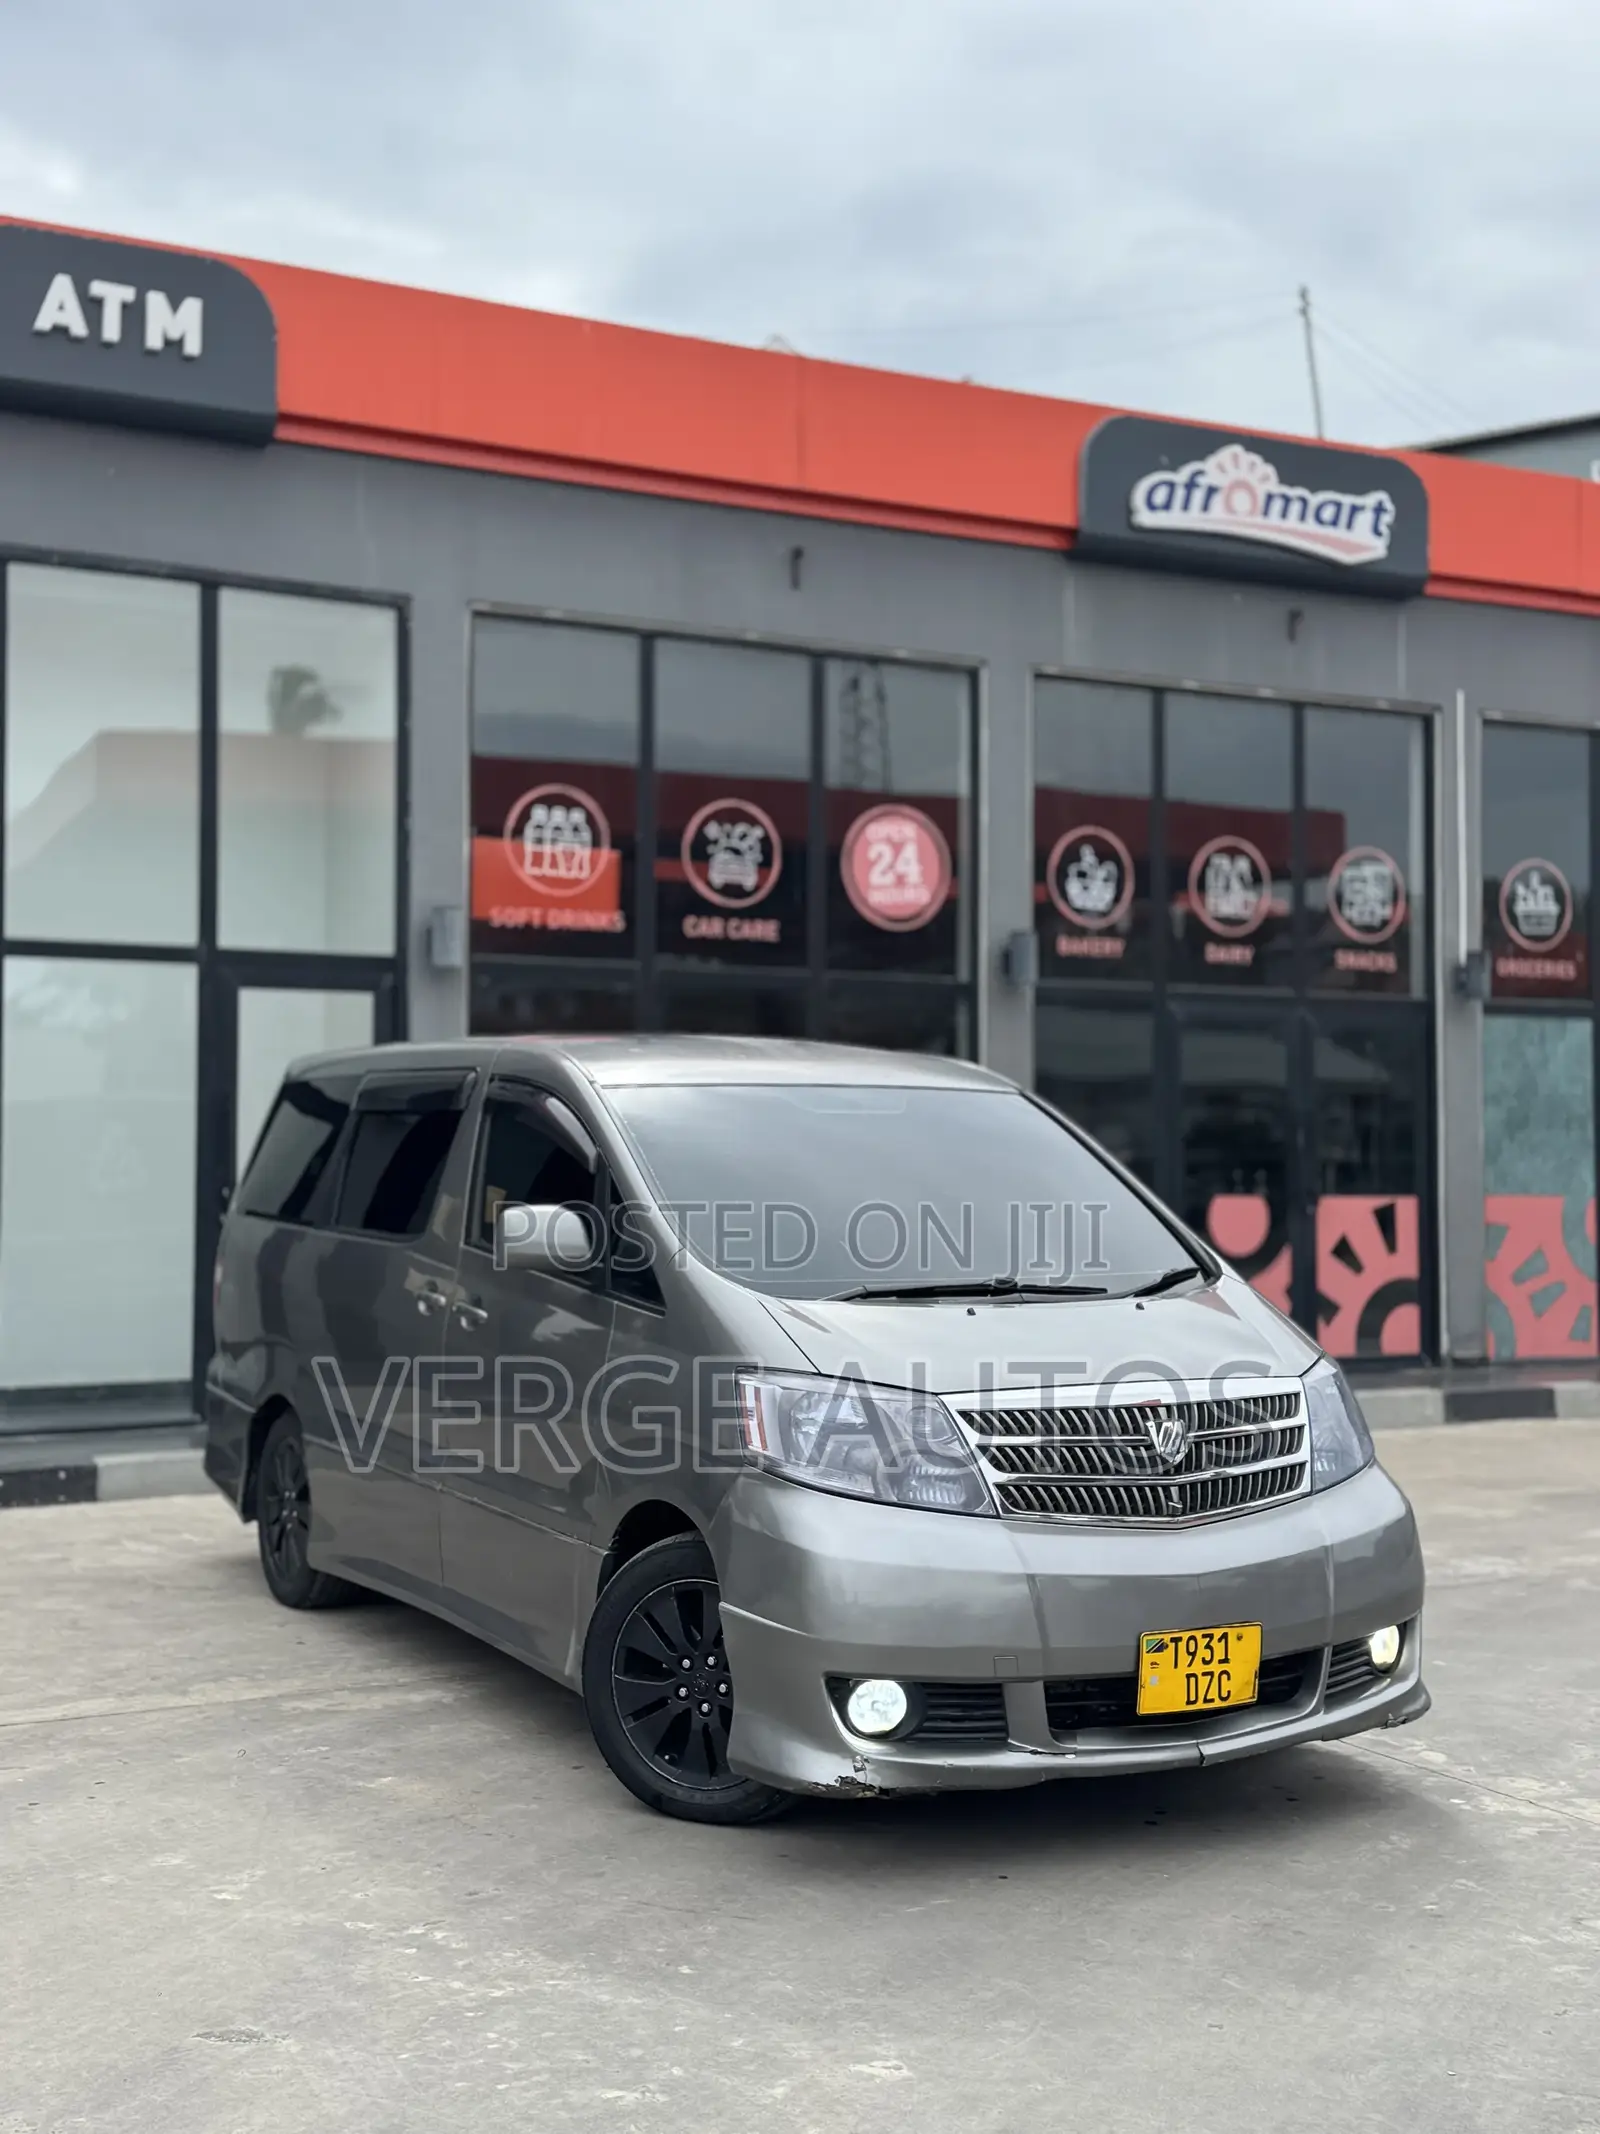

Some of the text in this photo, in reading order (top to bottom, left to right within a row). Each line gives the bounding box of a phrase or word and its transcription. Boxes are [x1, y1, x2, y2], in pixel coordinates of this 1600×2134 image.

[32, 273, 203, 358] ATM
[1144, 468, 1391, 538] afromart
[867, 842, 924, 886] 24
[488, 905, 627, 934] SOFT DRINKS
[682, 914, 782, 943] CAR CARE
[1169, 1632, 1231, 1669] T931
[1185, 1669, 1232, 1706] DZC
